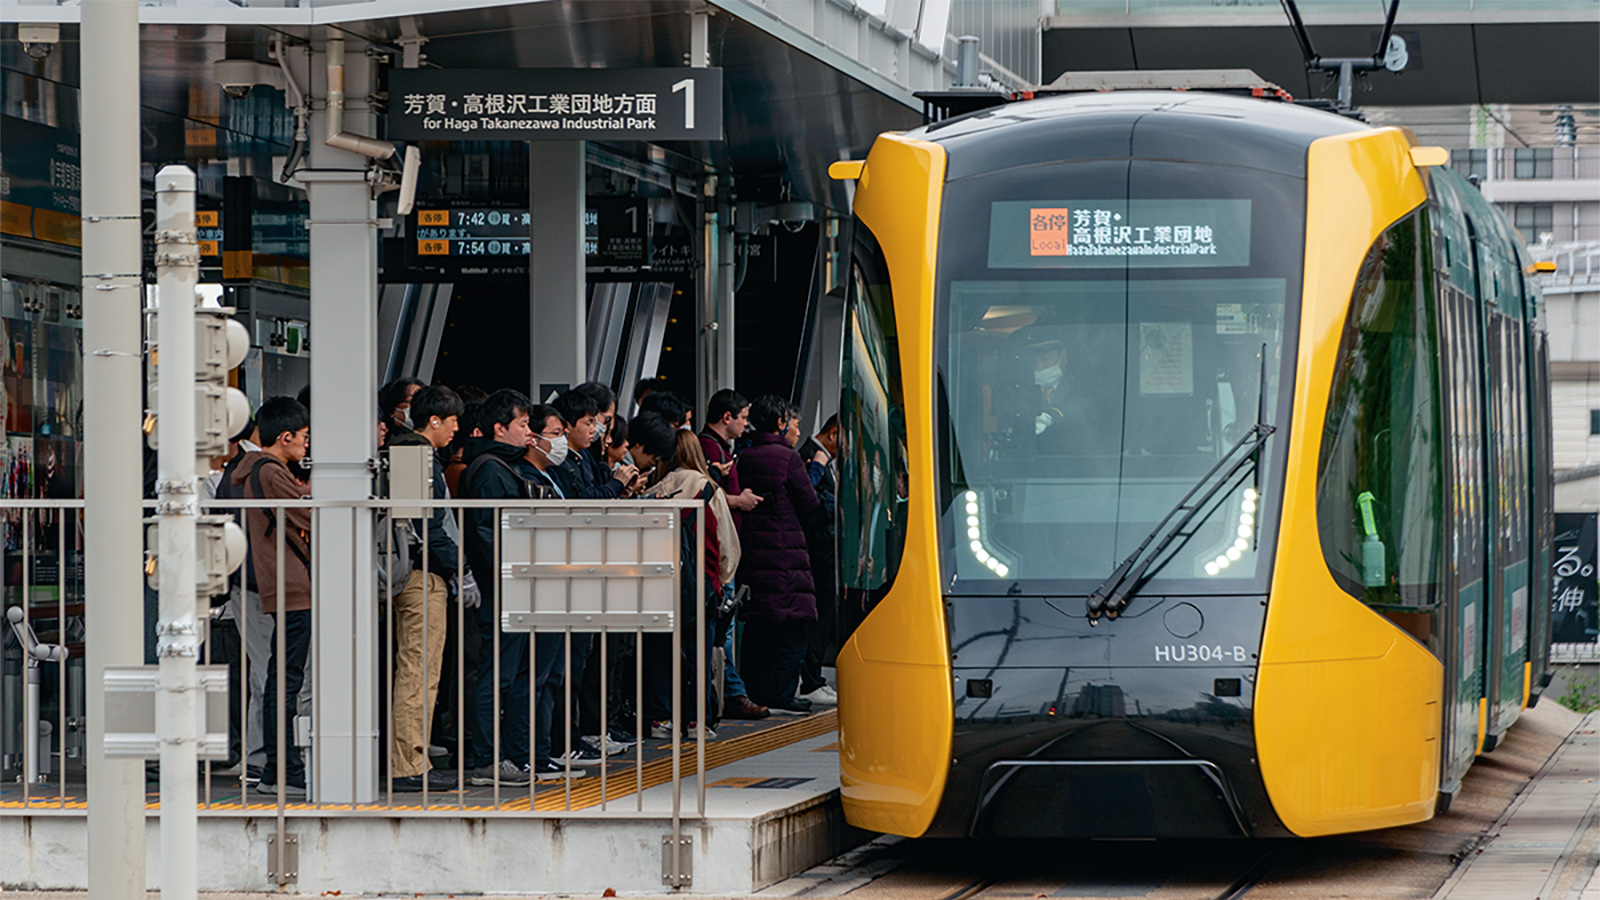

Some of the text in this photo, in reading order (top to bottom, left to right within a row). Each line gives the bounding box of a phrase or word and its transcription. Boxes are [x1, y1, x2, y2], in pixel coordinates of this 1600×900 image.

[403, 93, 657, 115] 芳賀・高根沢工業団地方面
[671, 78, 695, 129] 1
[423, 117, 656, 132] for Haga Takanezawa Industrial Park
[143, 208, 156, 235] 2
[458, 212, 485, 225] 7:42
[625, 206, 637, 233] 1
[1032, 214, 1066, 231] 各停
[1073, 225, 1213, 244] 高根沢工業団地
[458, 242, 485, 255] 7:54
[1032, 239, 1066, 250] Local
[1155, 645, 1246, 661] HU304-B
